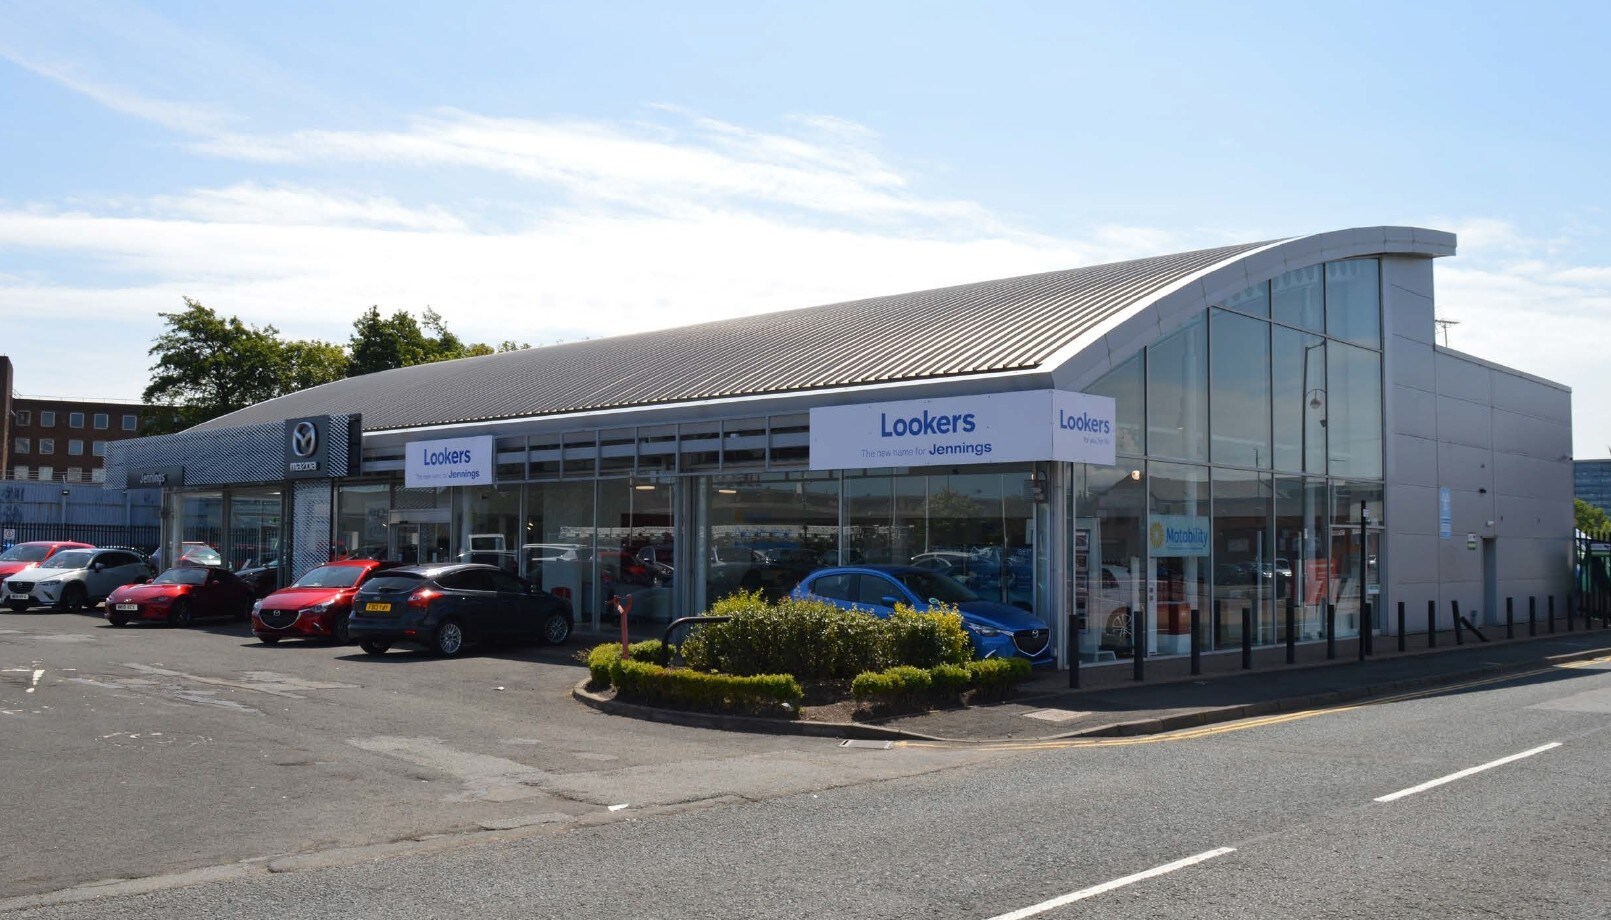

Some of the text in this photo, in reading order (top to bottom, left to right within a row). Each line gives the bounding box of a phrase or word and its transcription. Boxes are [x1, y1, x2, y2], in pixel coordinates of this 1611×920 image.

[881, 410, 976, 438] Lookers
[1060, 409, 1110, 434] Lookers
[424, 446, 471, 466] Lookers
[861, 442, 992, 458] The new name for Jennings
[448, 470, 480, 480] Jennings
[1166, 527, 1208, 548] Motability
